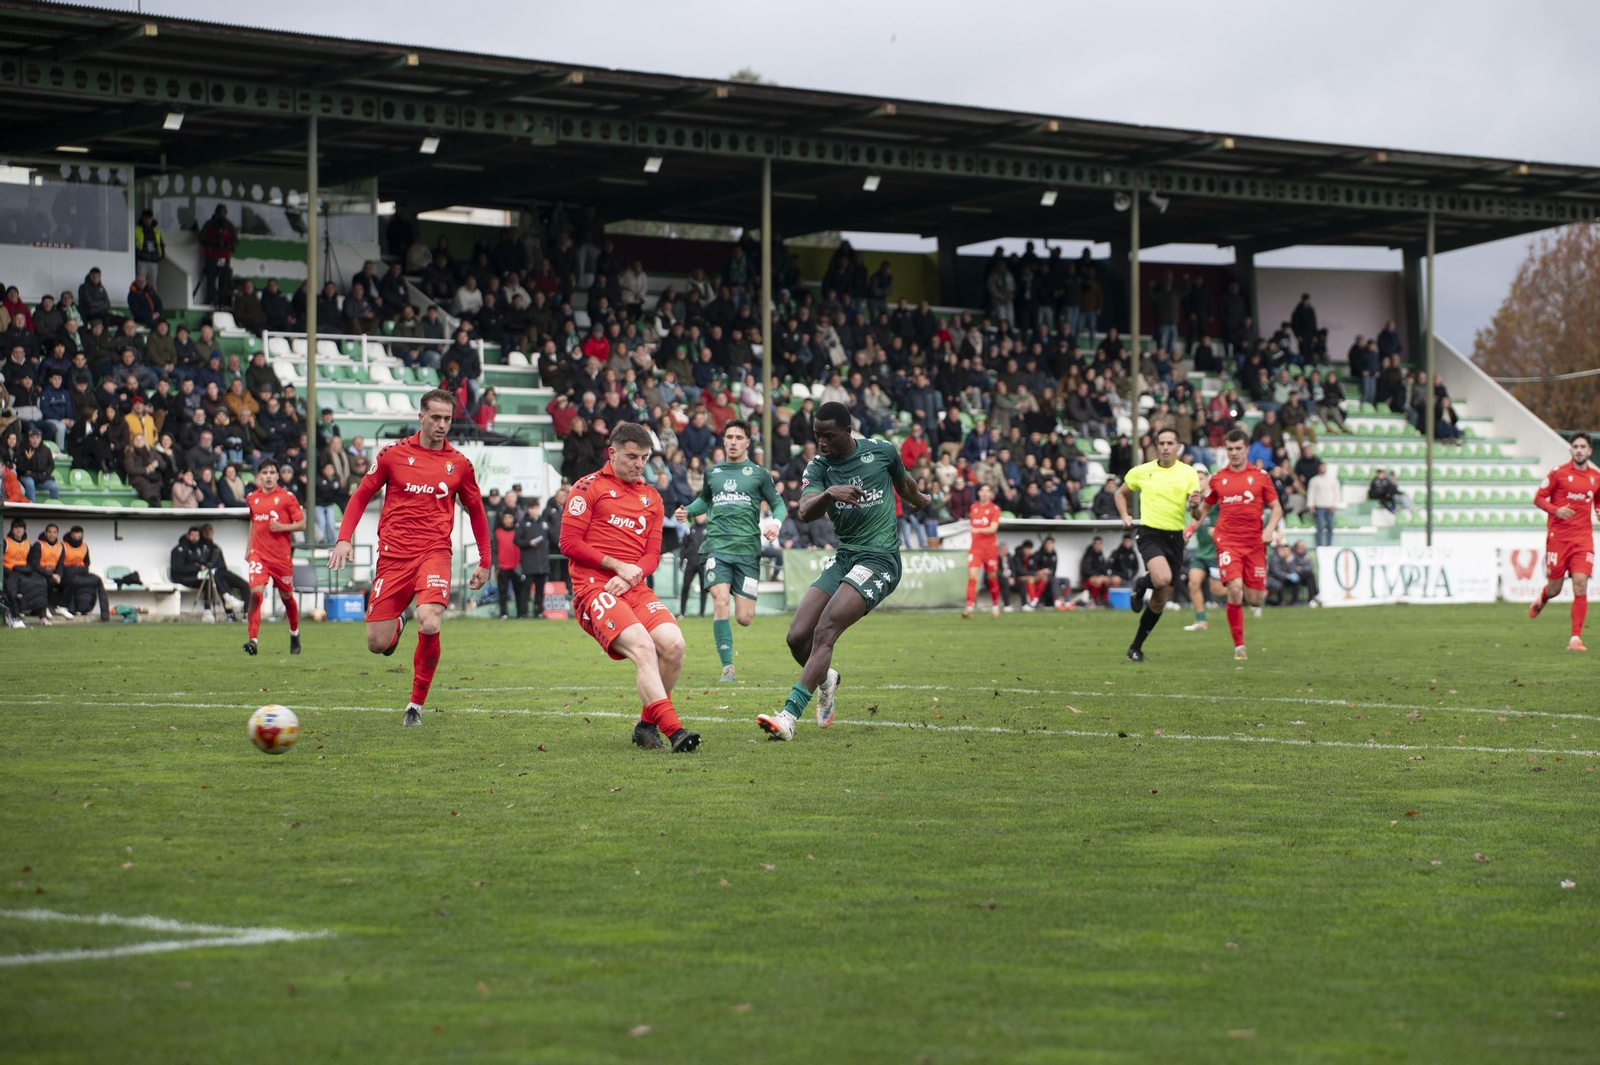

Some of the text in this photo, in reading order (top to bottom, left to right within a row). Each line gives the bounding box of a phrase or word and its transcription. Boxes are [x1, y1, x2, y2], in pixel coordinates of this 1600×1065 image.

[403, 482, 435, 495] Jaylo
[607, 513, 636, 529] Jaylo
[1219, 551, 1232, 567] 16
[1547, 551, 1558, 566] 14
[249, 560, 263, 575] 22
[374, 578, 385, 598] 4
[590, 591, 617, 620] 30
